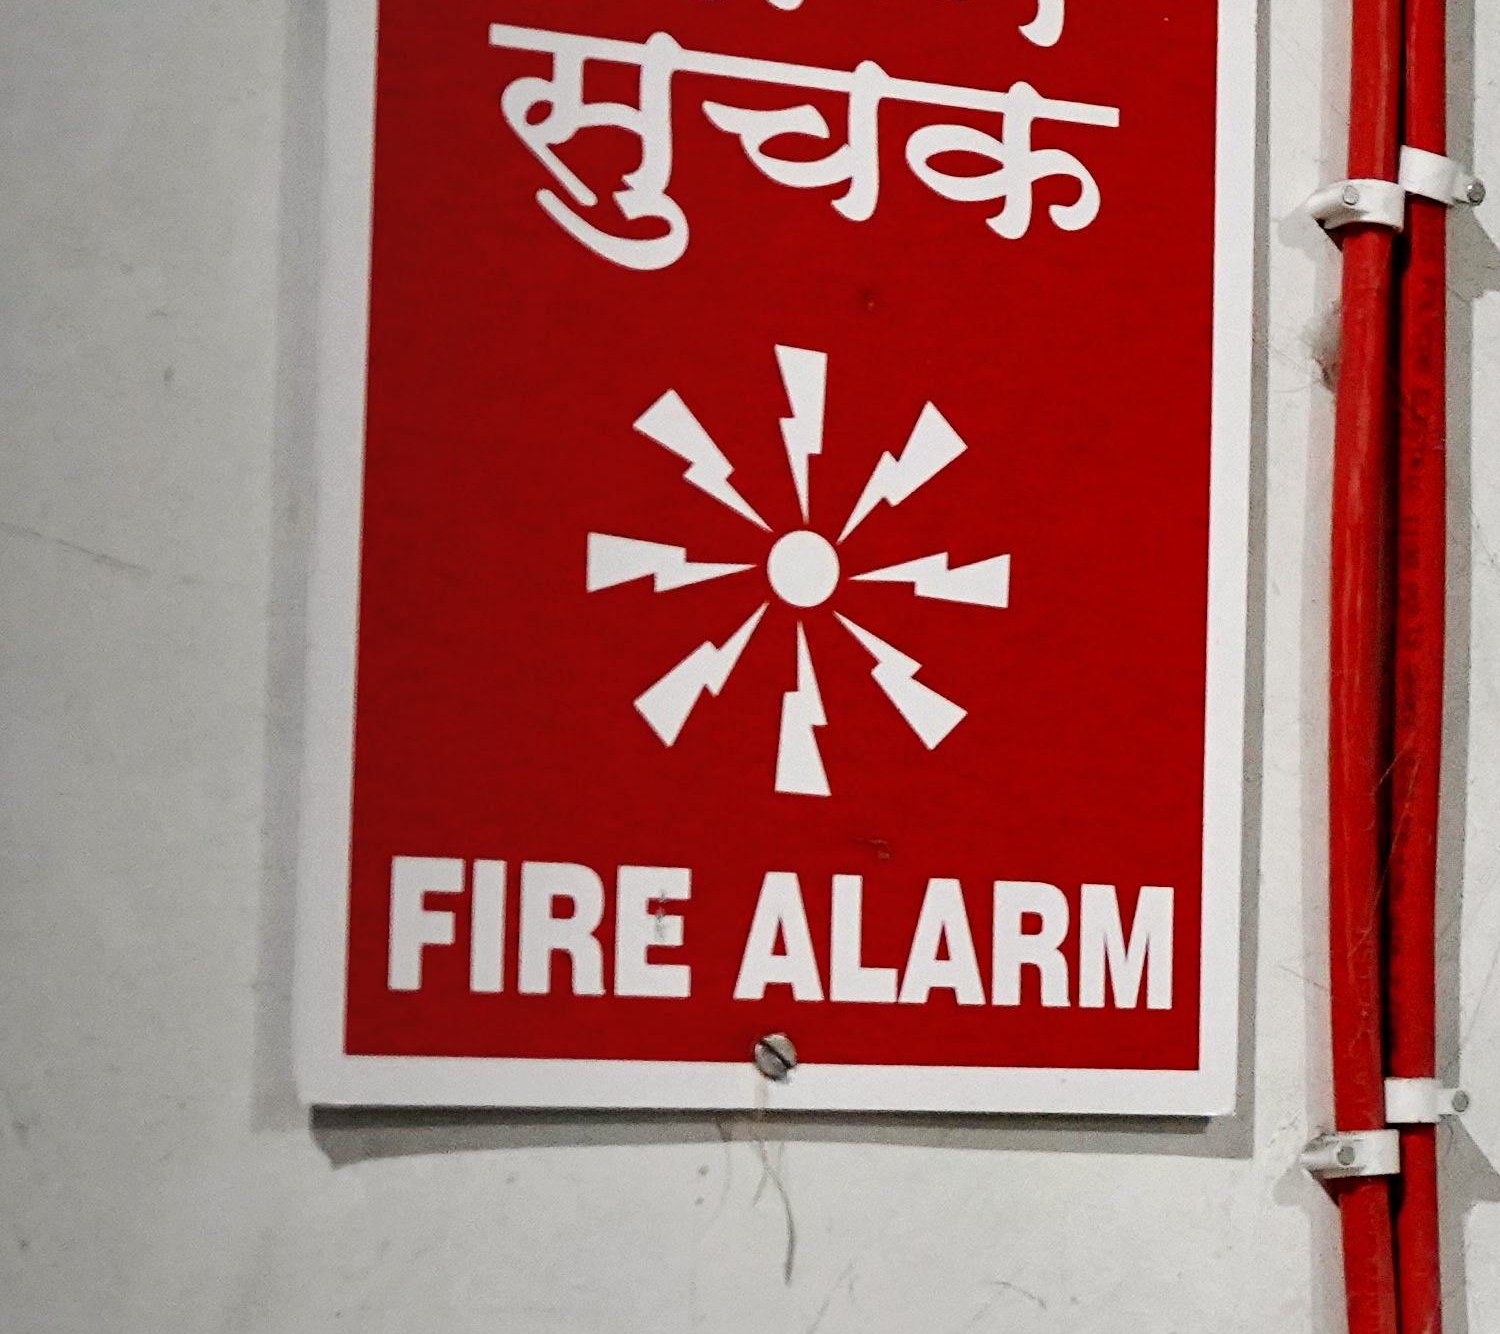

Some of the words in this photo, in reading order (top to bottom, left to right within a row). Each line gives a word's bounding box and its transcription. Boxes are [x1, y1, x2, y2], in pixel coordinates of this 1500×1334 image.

[490, 24, 1119, 270] सुचक
[388, 856, 692, 998] FIRE
[733, 872, 1175, 1010] ALARM
